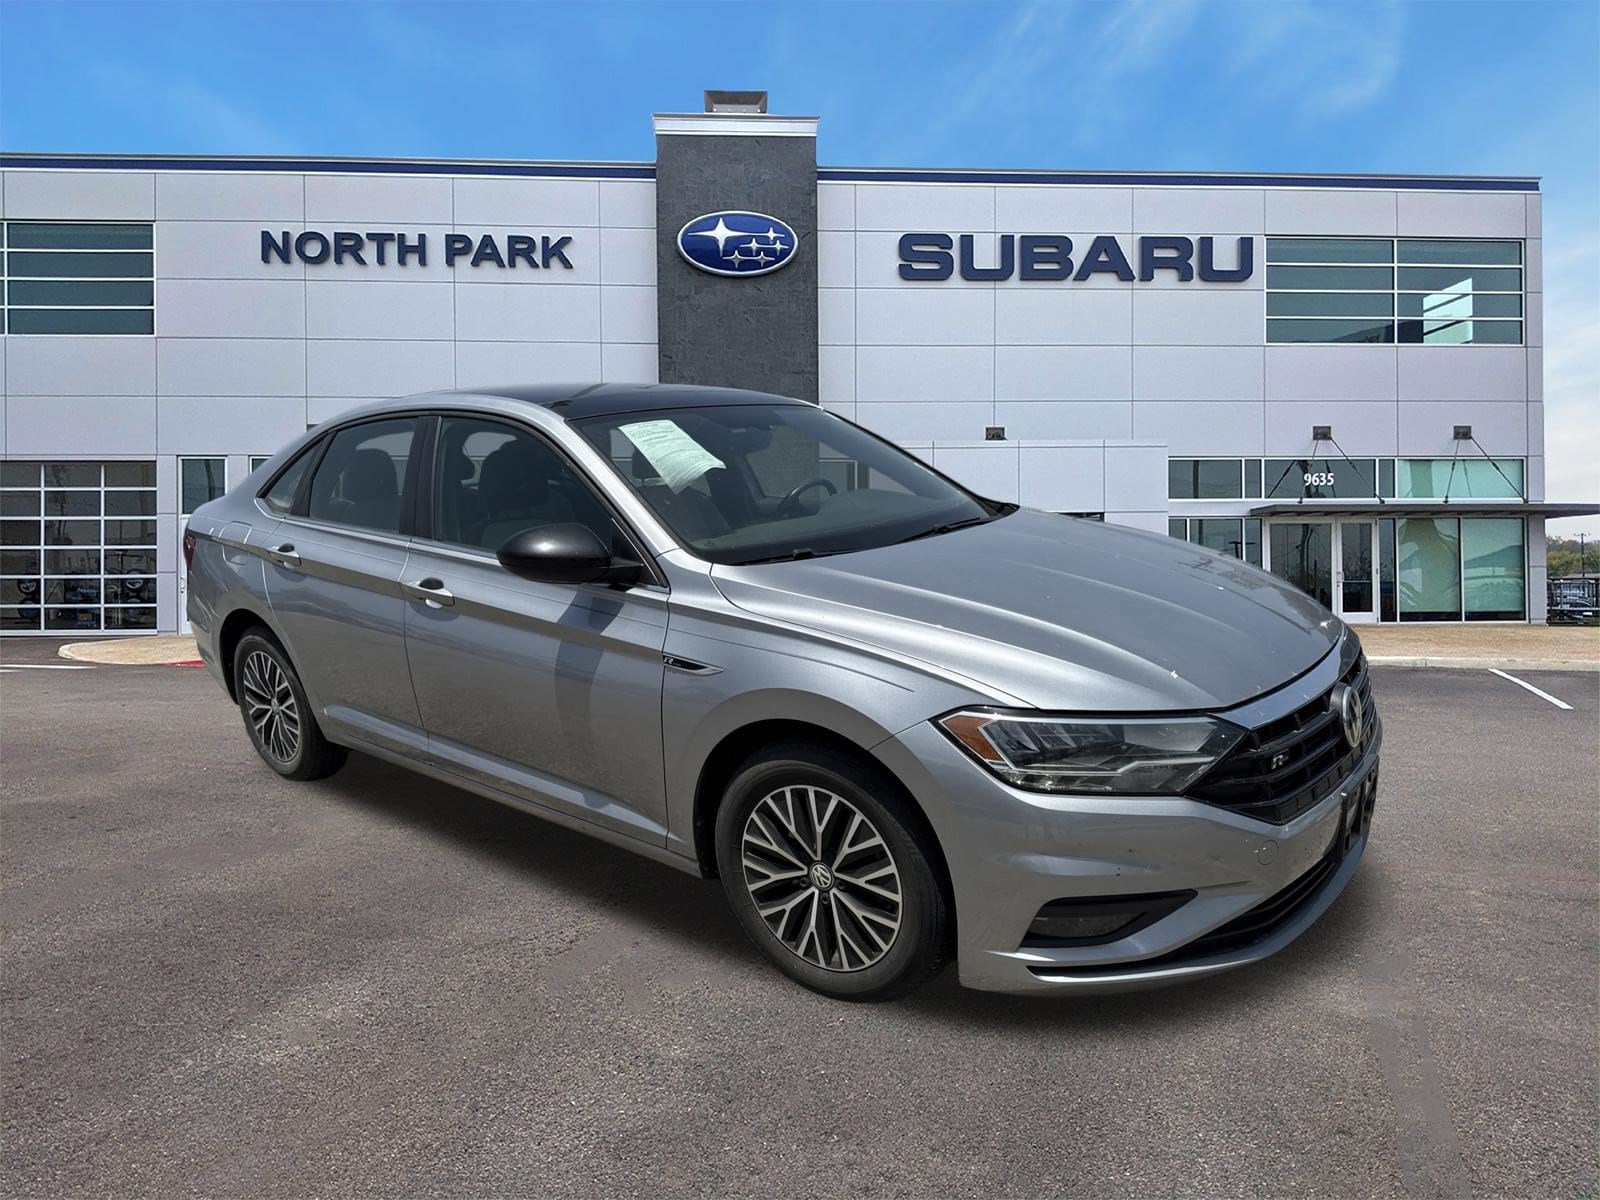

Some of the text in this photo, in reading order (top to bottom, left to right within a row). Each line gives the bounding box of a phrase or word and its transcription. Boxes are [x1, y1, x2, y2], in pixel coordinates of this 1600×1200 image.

[261, 230, 574, 269] NORTH PARK
[898, 233, 1254, 282] SUBARU
[1303, 472, 1335, 486] 9635
